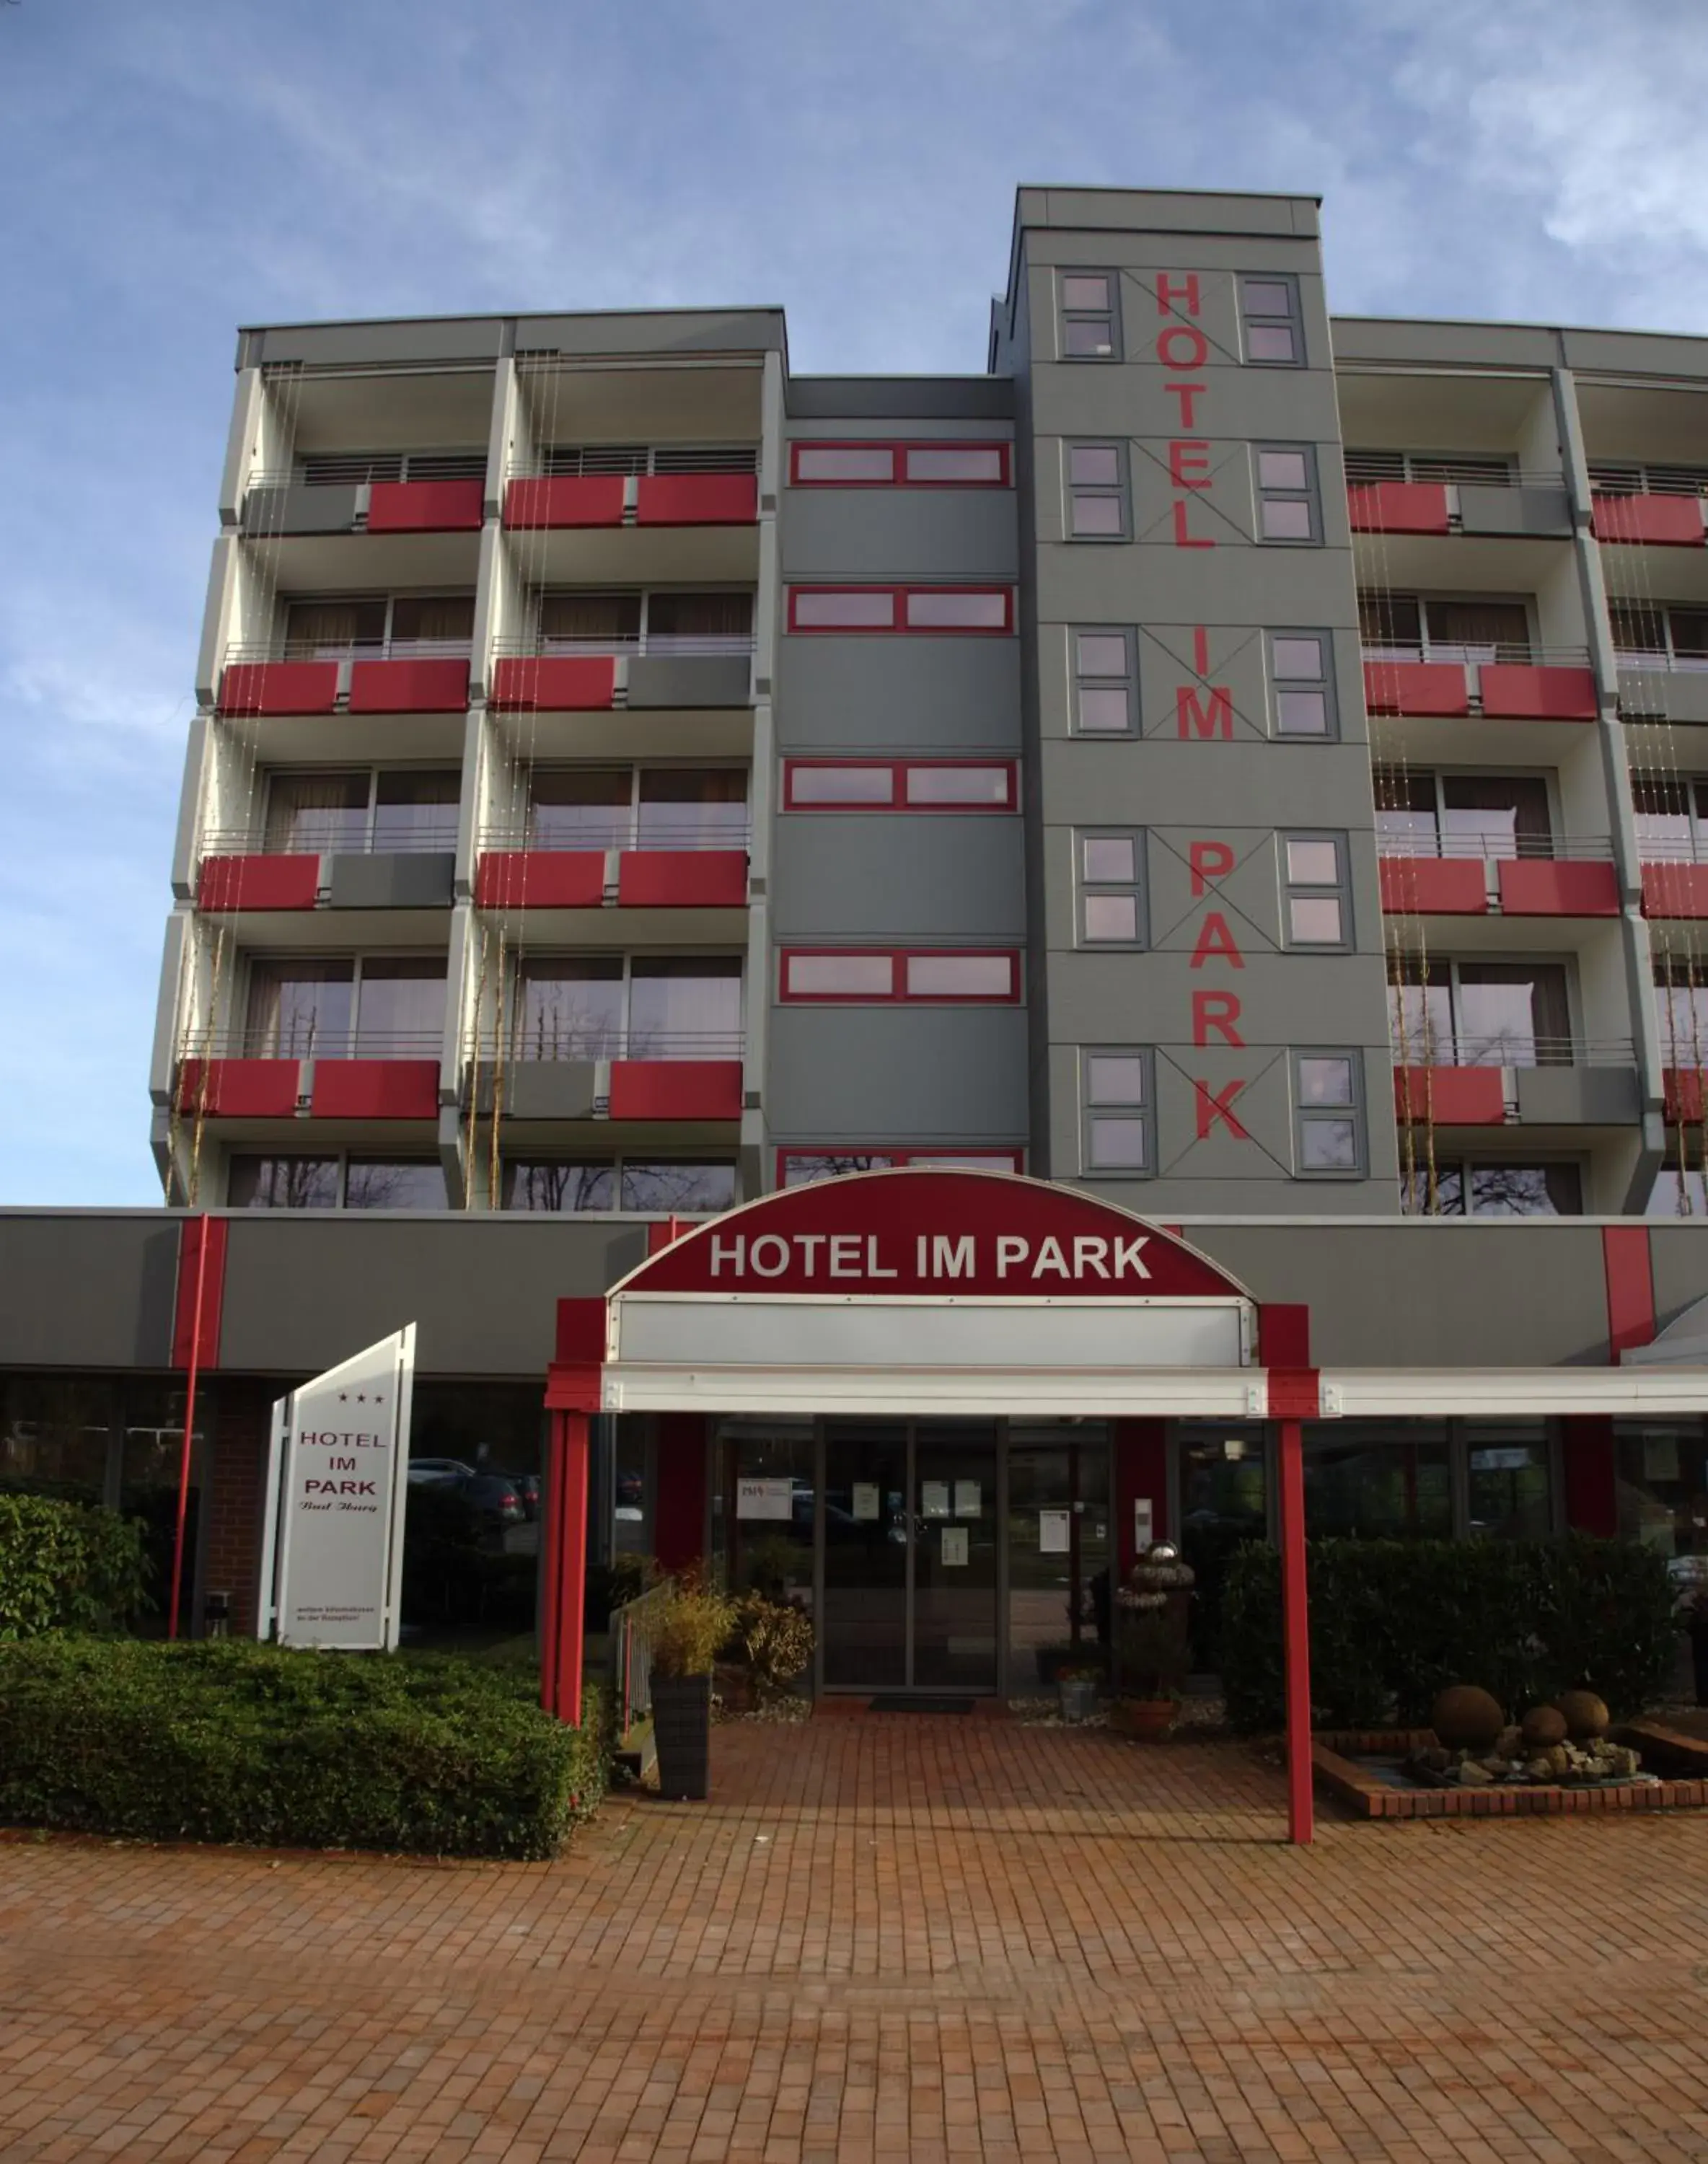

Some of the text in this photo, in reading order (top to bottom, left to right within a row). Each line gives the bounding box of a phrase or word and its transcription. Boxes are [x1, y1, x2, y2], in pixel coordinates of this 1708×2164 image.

[1156, 273, 1249, 1140] HOTEL IM PARK
[710, 1234, 1153, 1280] HOTEL IM PARK
[300, 1432, 386, 1448] HOTEL
[329, 1456, 356, 1471] IM
[304, 1479, 377, 1495] PARK
